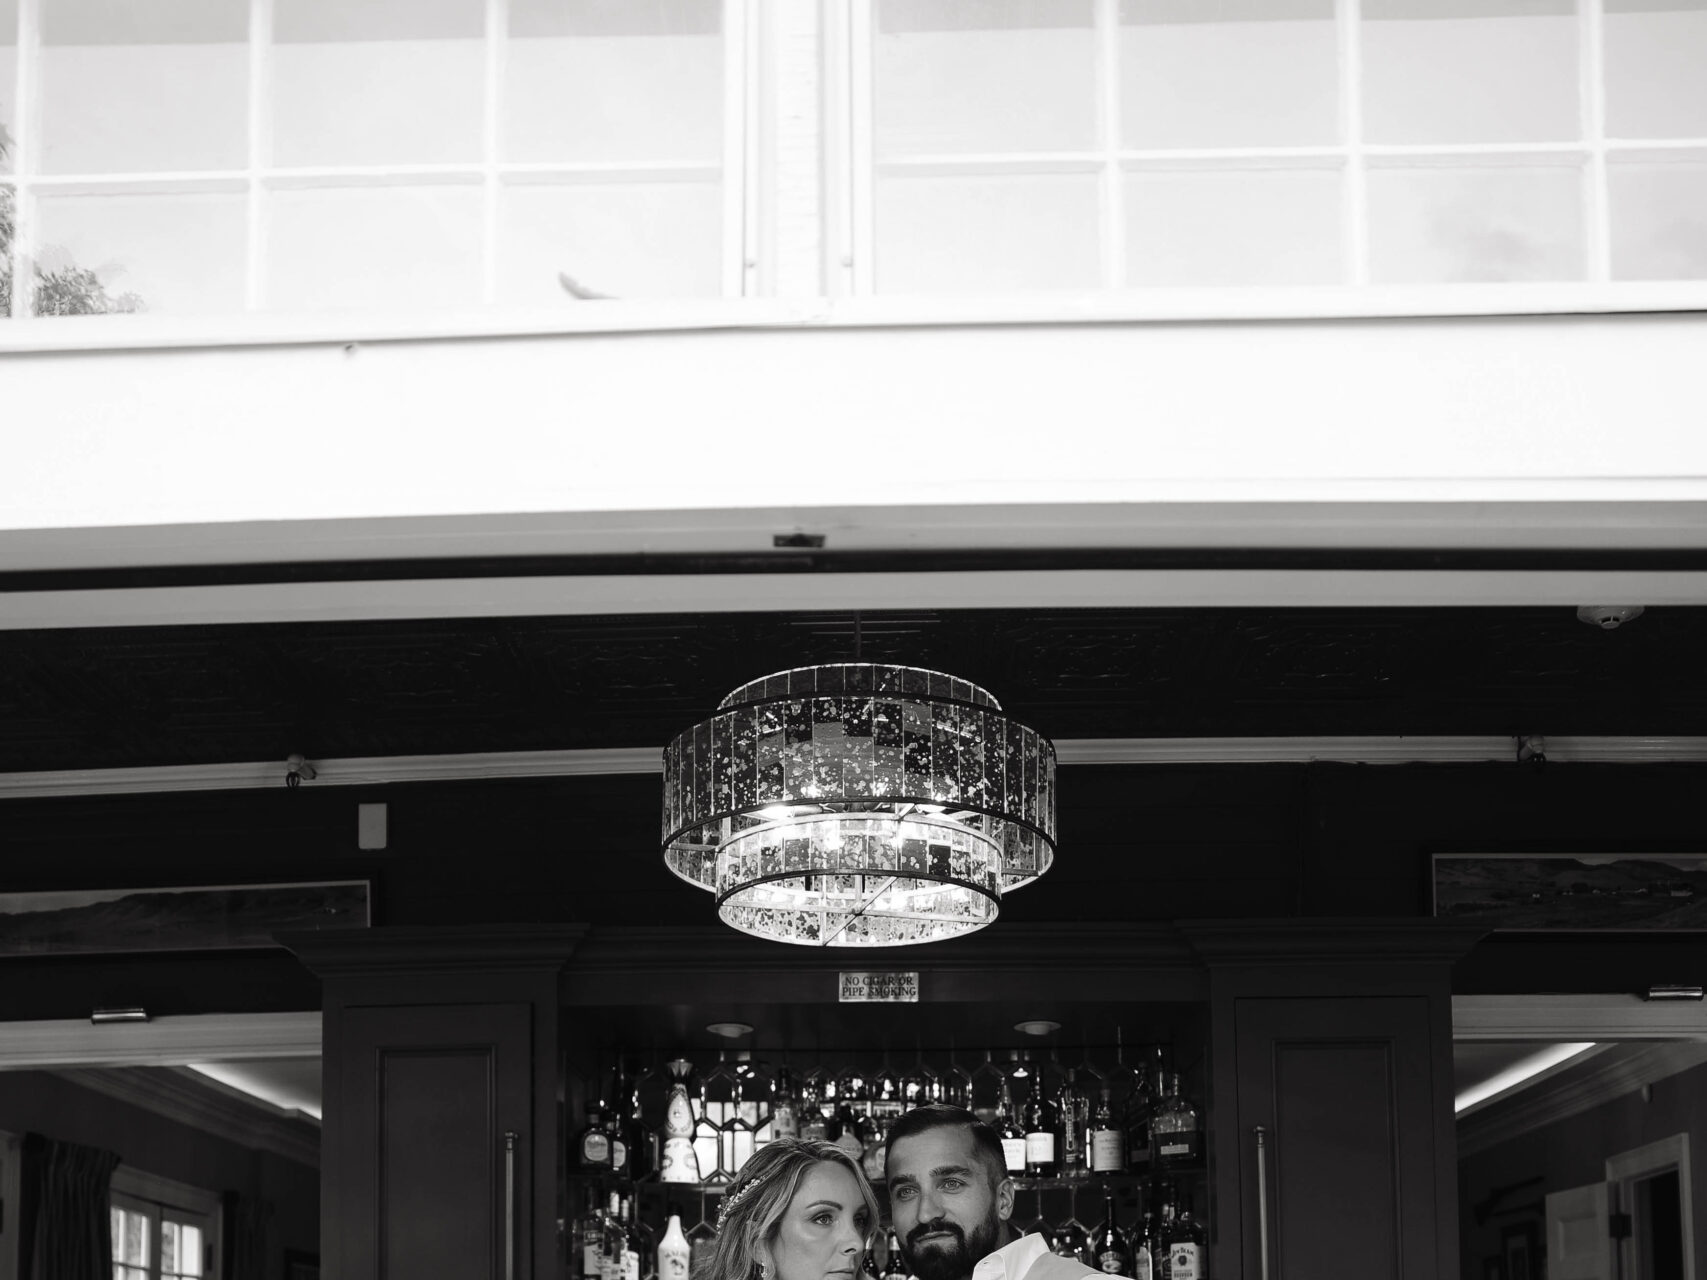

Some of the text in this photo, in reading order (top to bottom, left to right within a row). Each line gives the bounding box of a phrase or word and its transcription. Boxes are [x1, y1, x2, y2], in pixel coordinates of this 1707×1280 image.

[845, 976, 914, 986] NO CIGAR OR
[842, 986, 917, 997] PIPE SMOKING
